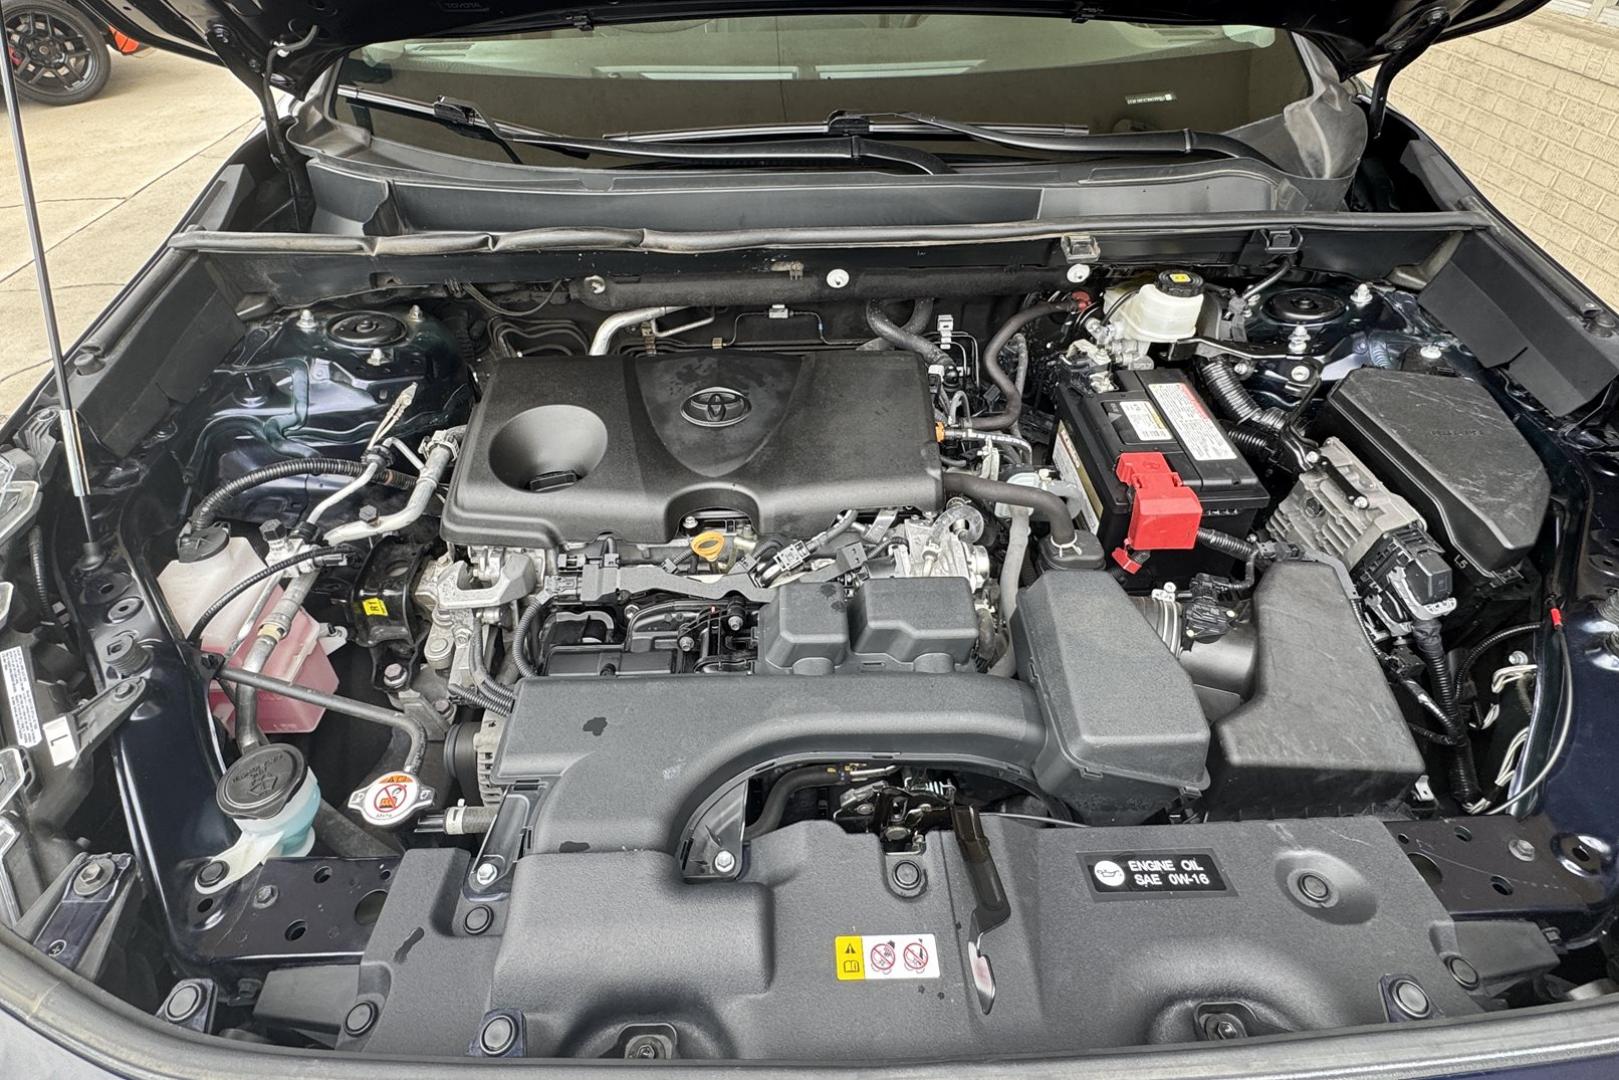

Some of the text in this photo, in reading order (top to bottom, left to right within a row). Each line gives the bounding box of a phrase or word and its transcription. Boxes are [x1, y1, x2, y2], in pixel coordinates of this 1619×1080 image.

[1127, 860, 1204, 872] ENGINE OIL
[1134, 873, 1210, 886] SAE 0W-16
